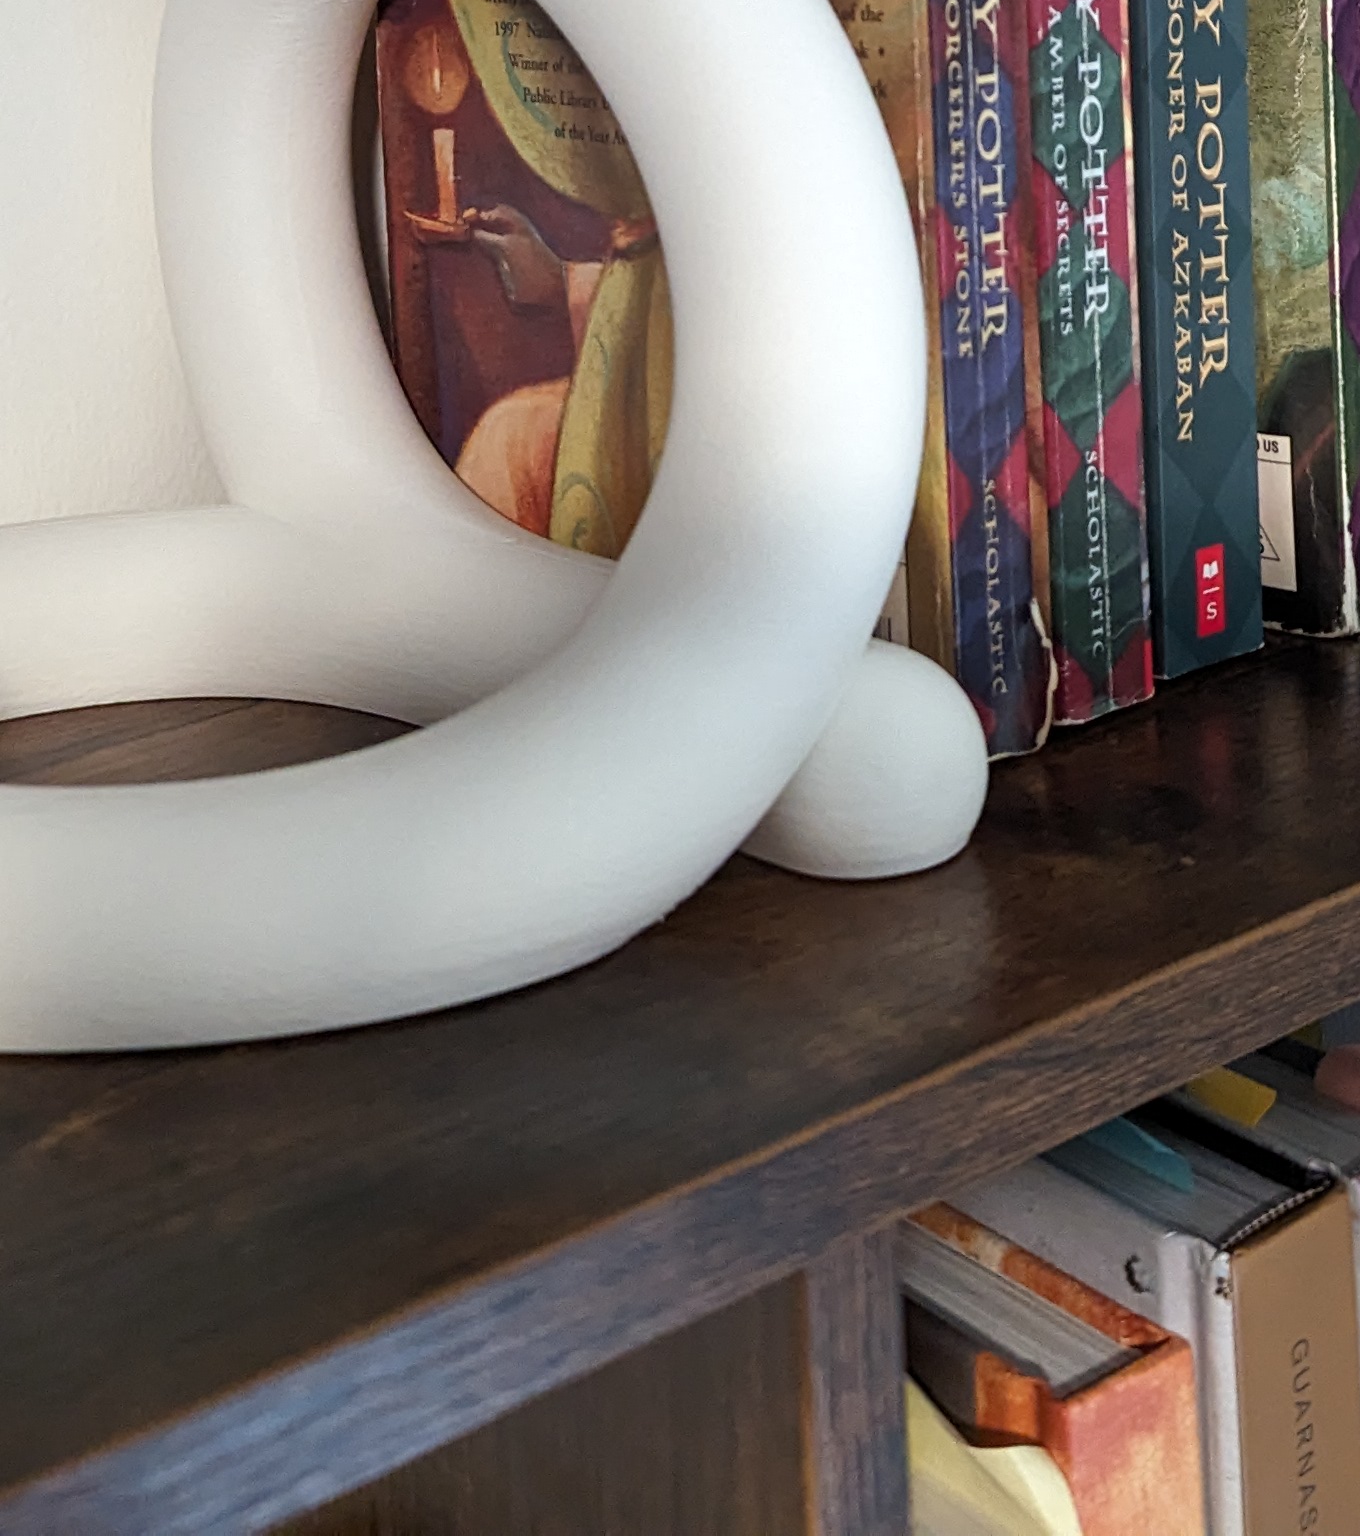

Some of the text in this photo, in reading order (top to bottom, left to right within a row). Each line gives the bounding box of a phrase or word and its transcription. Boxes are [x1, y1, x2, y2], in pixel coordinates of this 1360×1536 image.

[975, 68, 1010, 351] POTTER
[1053, 144, 1069, 190] OF
[1055, 199, 1075, 337] SECRETS
[1077, 52, 1112, 330] POTTER
[1171, 154, 1191, 213] OF
[1195, 75, 1231, 389] POTTER
[953, 225, 975, 359] STONE
[1172, 229, 1194, 443] AZKABAN
[1263, 441, 1279, 455] US
[982, 478, 1009, 695] SCHOLASTIC
[1084, 450, 1105, 658] SCHOLASTIC
[1291, 1338, 1320, 1536] GUARNAS
